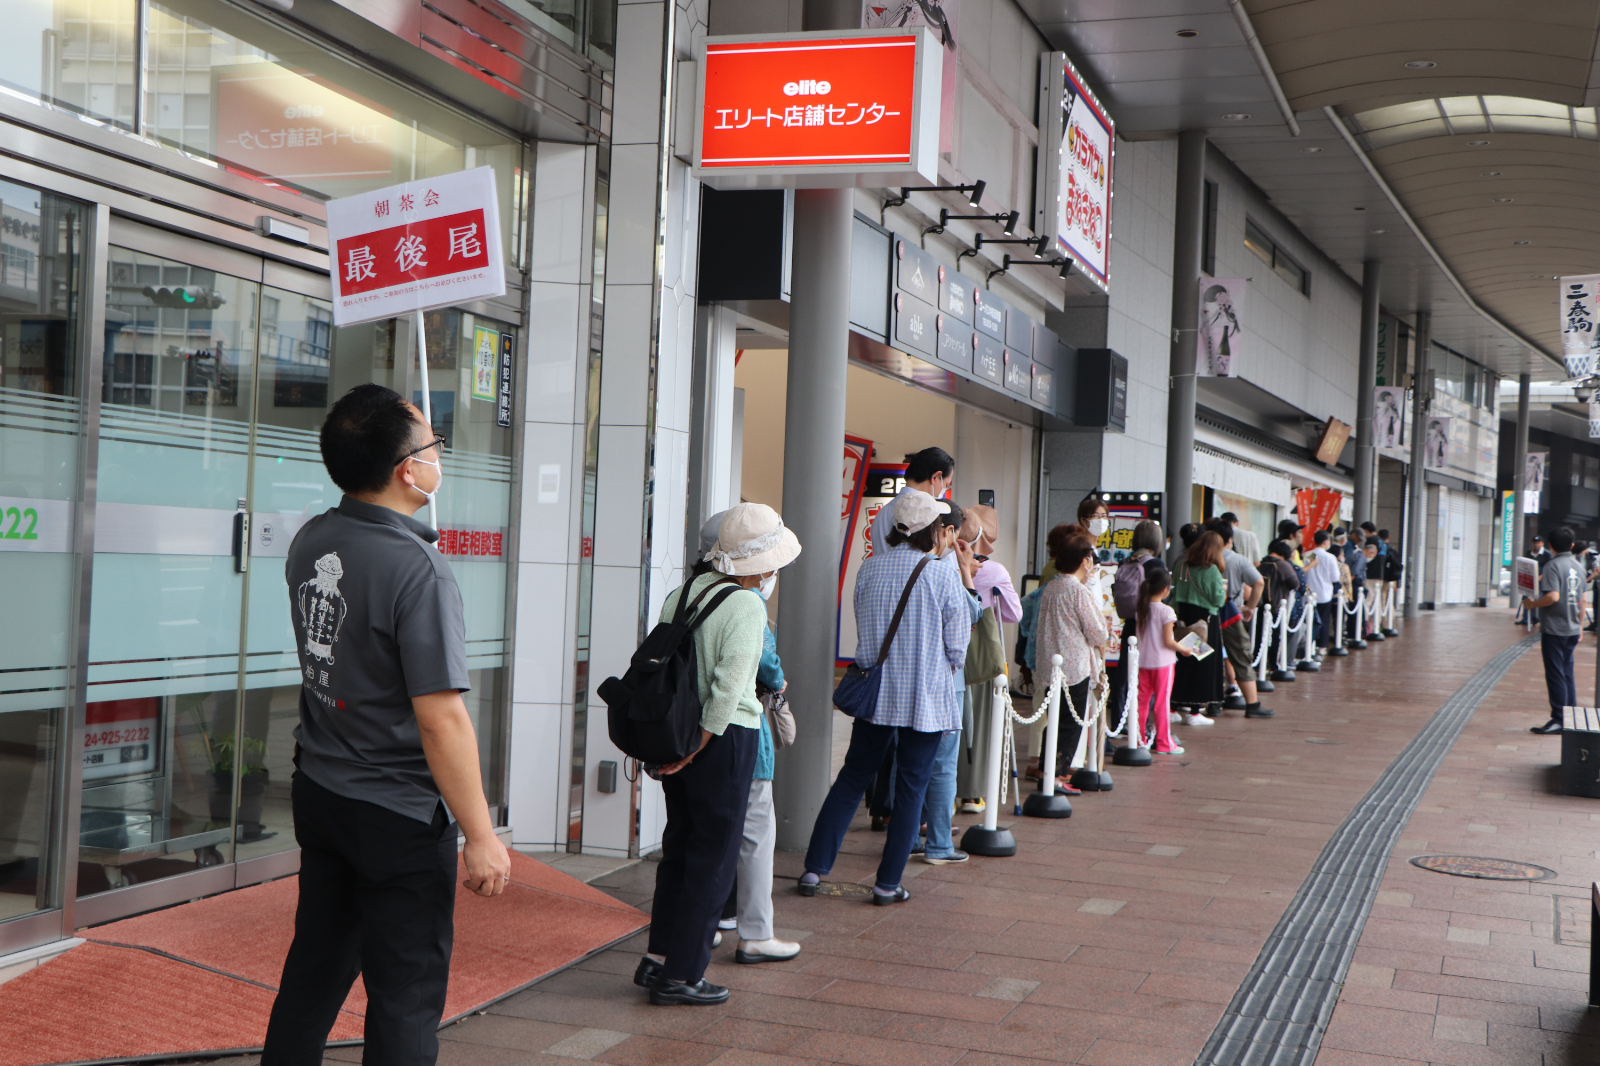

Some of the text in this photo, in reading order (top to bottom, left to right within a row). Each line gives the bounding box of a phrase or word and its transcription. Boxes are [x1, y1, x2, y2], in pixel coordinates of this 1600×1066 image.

[783, 79, 832, 97] elite
[713, 102, 901, 130] エリート店舗センター
[1073, 121, 1101, 184] カラオケ
[374, 188, 440, 218] 朝茶会
[1066, 169, 1102, 253] まねきねこ
[344, 222, 482, 283] 最後尾
[1563, 283, 1593, 334] 三春駒
[909, 313, 924, 336] able
[0, 506, 38, 540] 22
[305, 664, 330, 688] 柏屋
[84, 727, 149, 747] 24-925-2222
